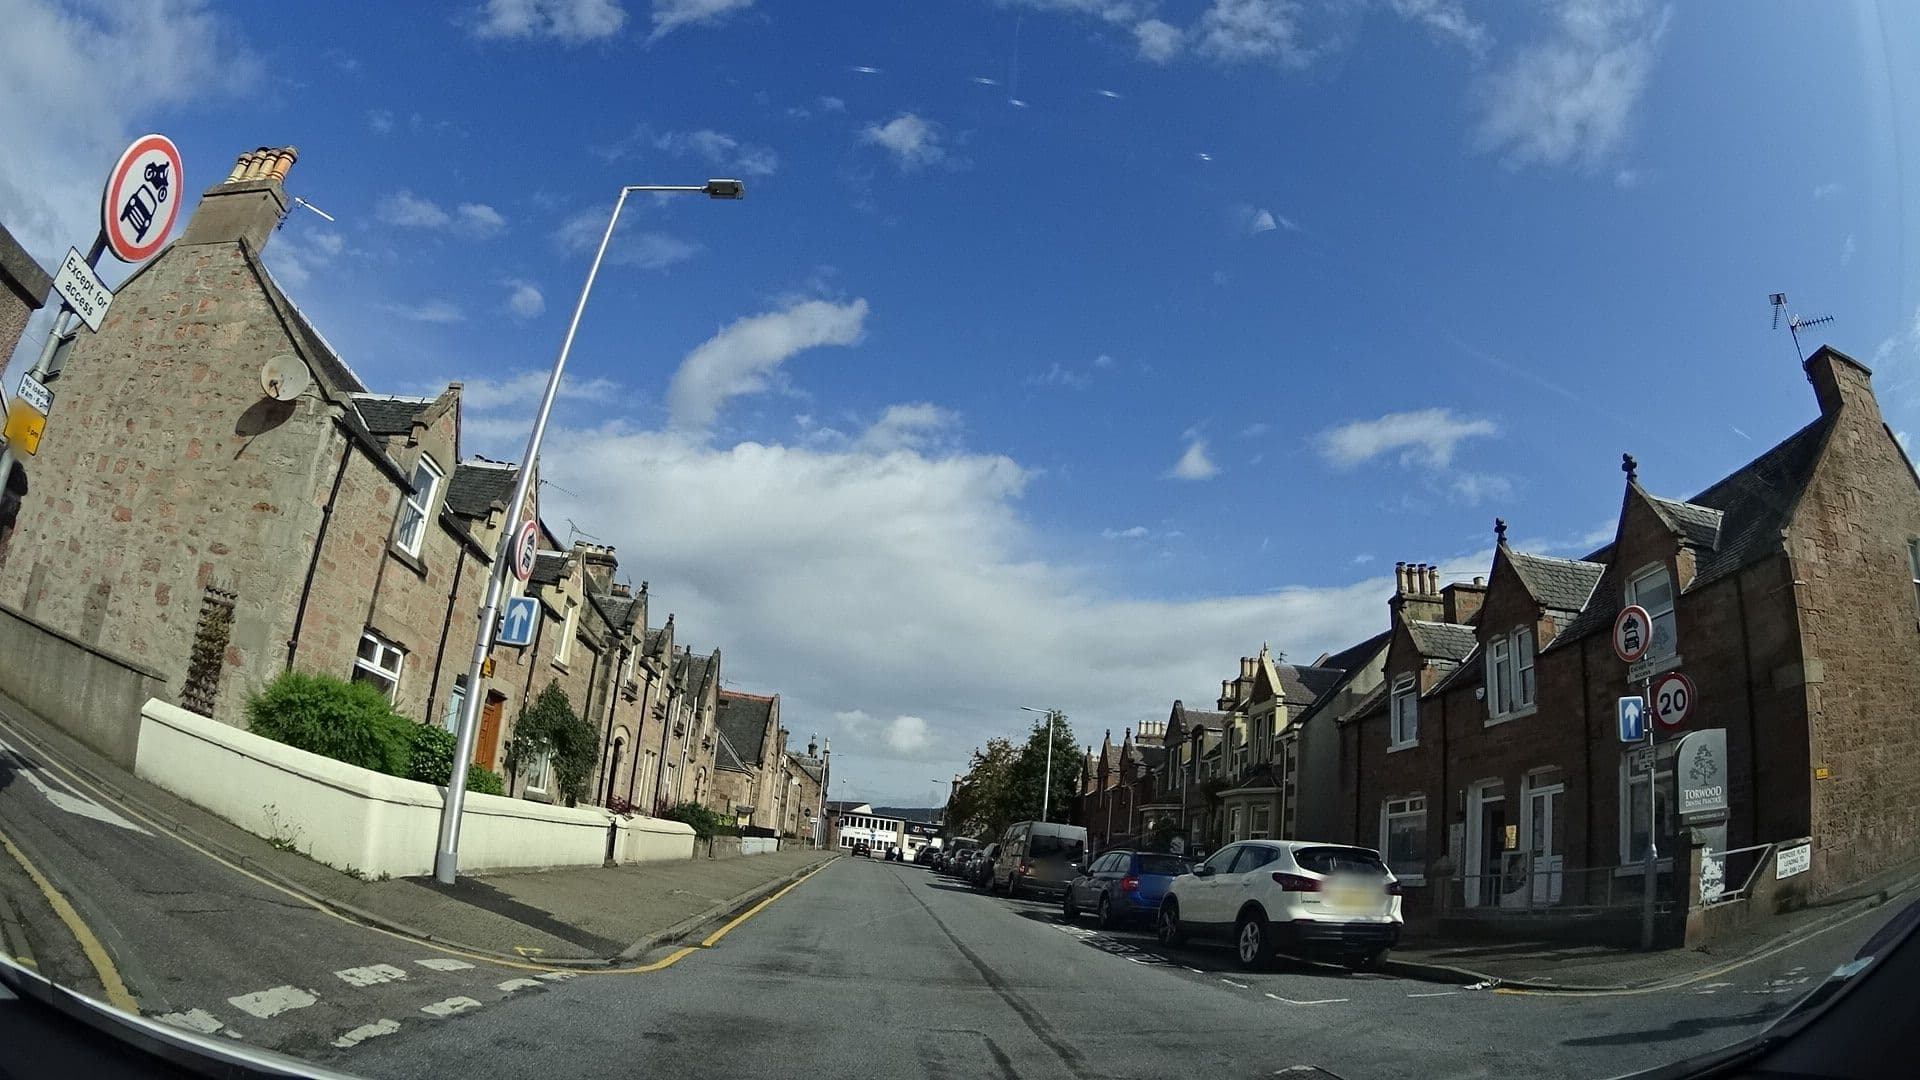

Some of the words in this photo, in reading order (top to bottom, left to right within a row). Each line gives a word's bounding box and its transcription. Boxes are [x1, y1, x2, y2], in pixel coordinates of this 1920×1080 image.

[66, 257, 94, 296] Except
[95, 291, 107, 309] for
[65, 281, 94, 317] access
[24, 377, 32, 388] No
[32, 384, 51, 404] loading
[25, 391, 33, 400] am
[1659, 688, 1687, 716] 20
[1684, 785, 1722, 800] TORWOOD
[1685, 799, 1702, 808] DENTAL
[1702, 796, 1722, 805] PRACTICE
